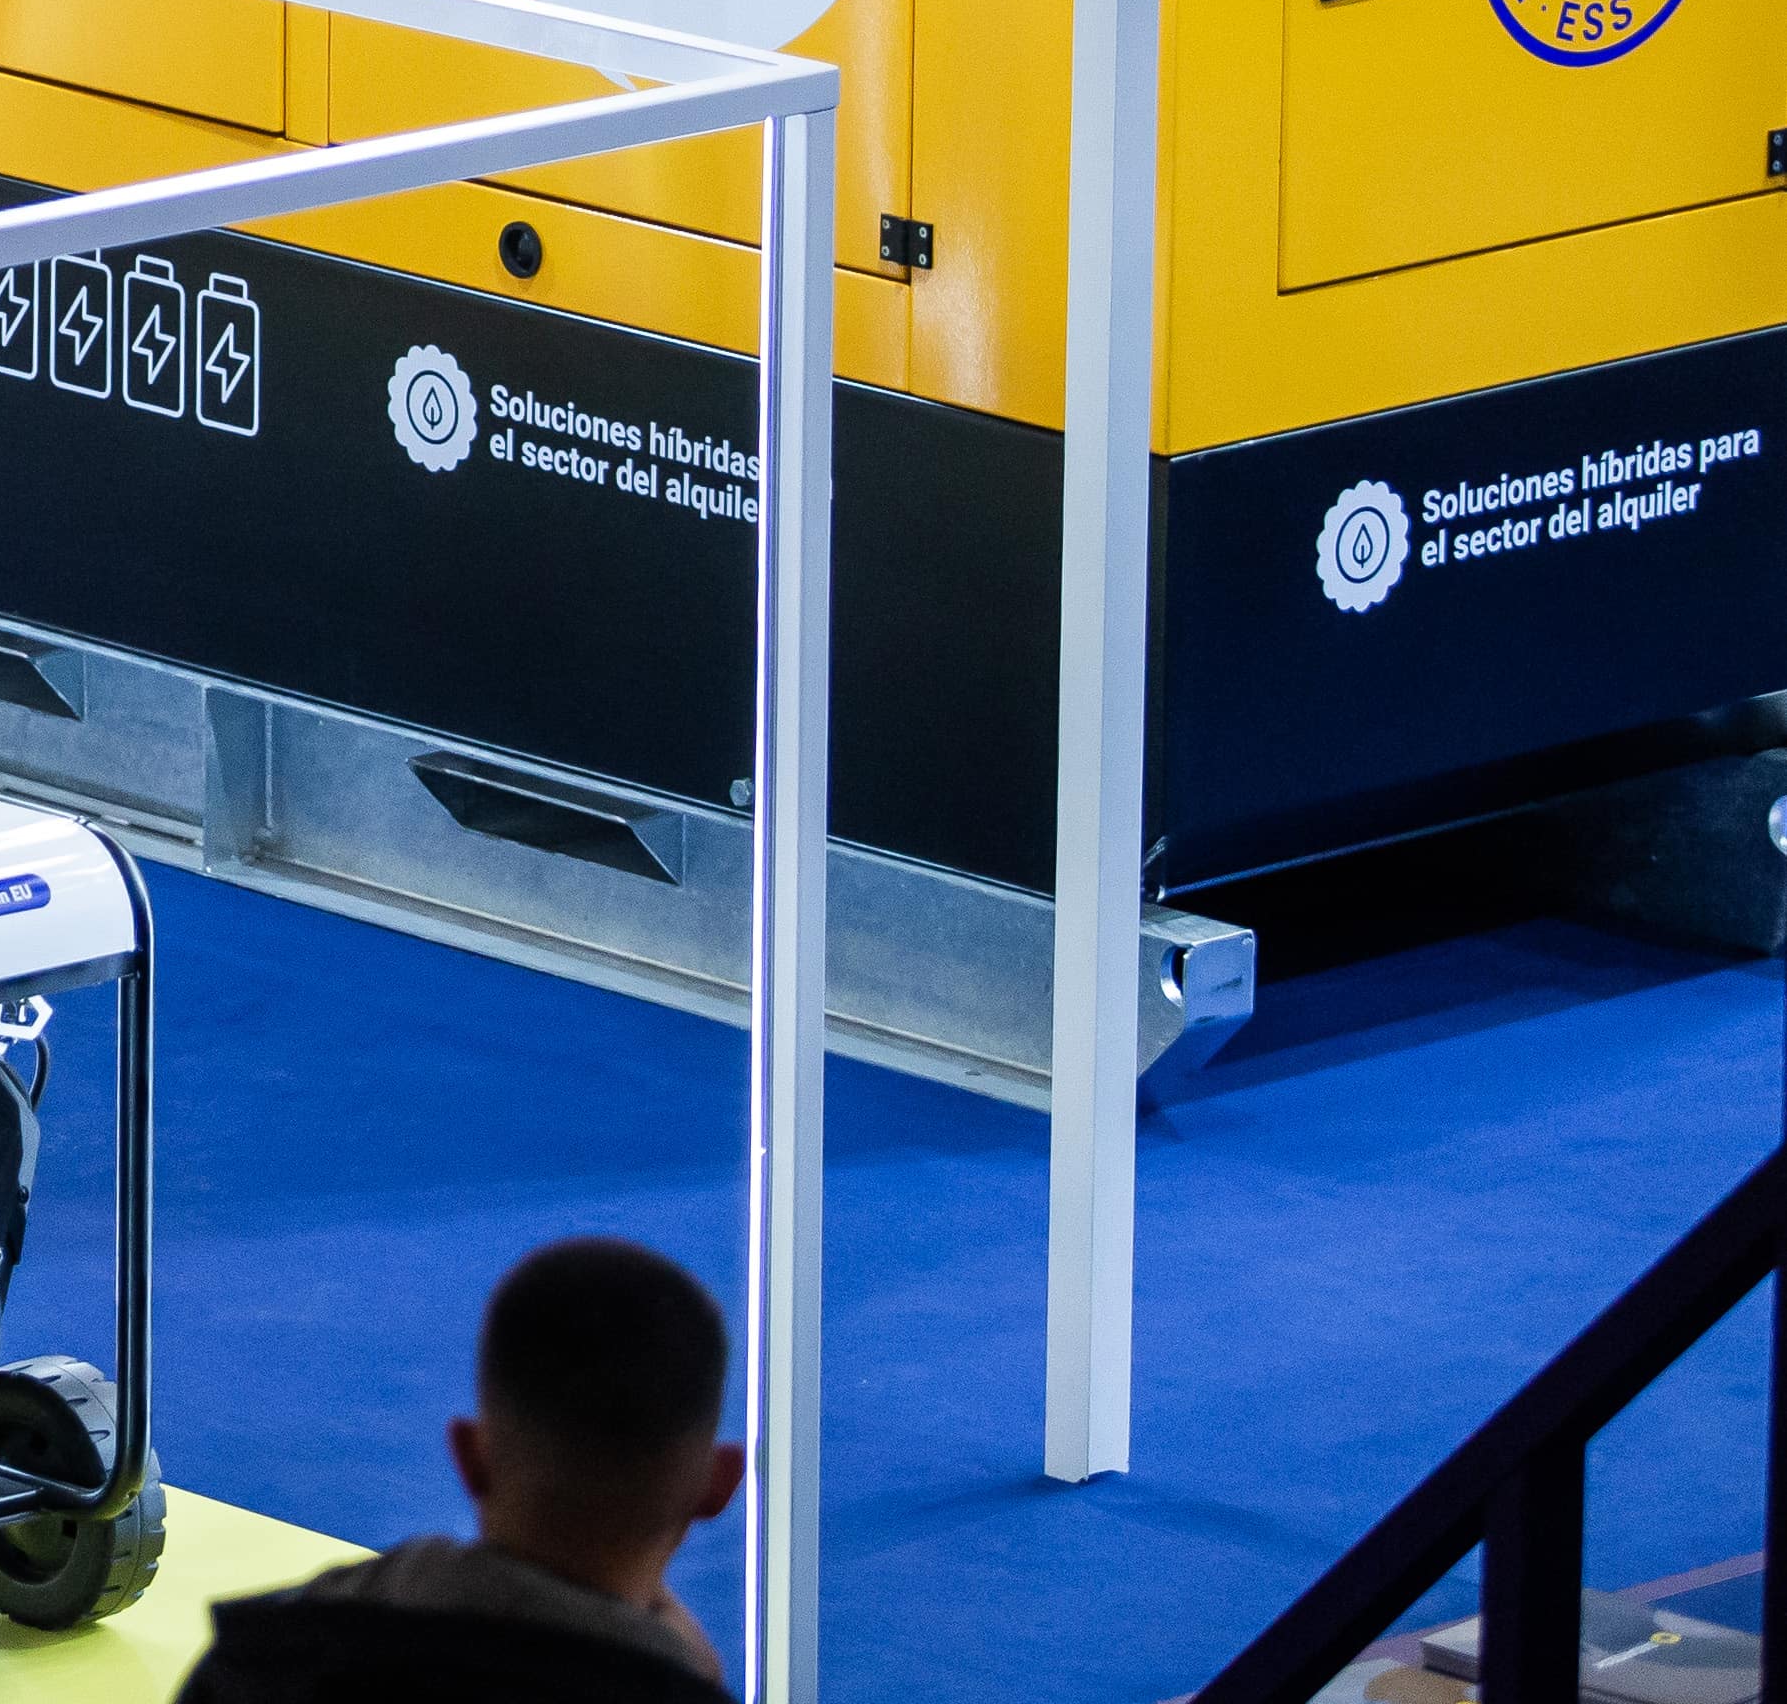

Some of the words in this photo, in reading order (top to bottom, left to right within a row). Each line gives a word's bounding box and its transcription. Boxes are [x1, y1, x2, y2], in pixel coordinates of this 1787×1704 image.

[490, 384, 642, 451] Soluciones
[649, 421, 760, 481] híbridas
[490, 428, 514, 462] el
[521, 441, 611, 486] sector
[615, 459, 657, 499] del
[1422, 466, 1574, 524] Soluciones
[1582, 439, 1691, 490] híbridas
[1700, 428, 1761, 472] para
[1422, 528, 1446, 566] el
[1453, 514, 1542, 560] sector
[1548, 497, 1590, 539] del
[1597, 479, 1701, 532] alquiler
[9, 884, 33, 901] EU
